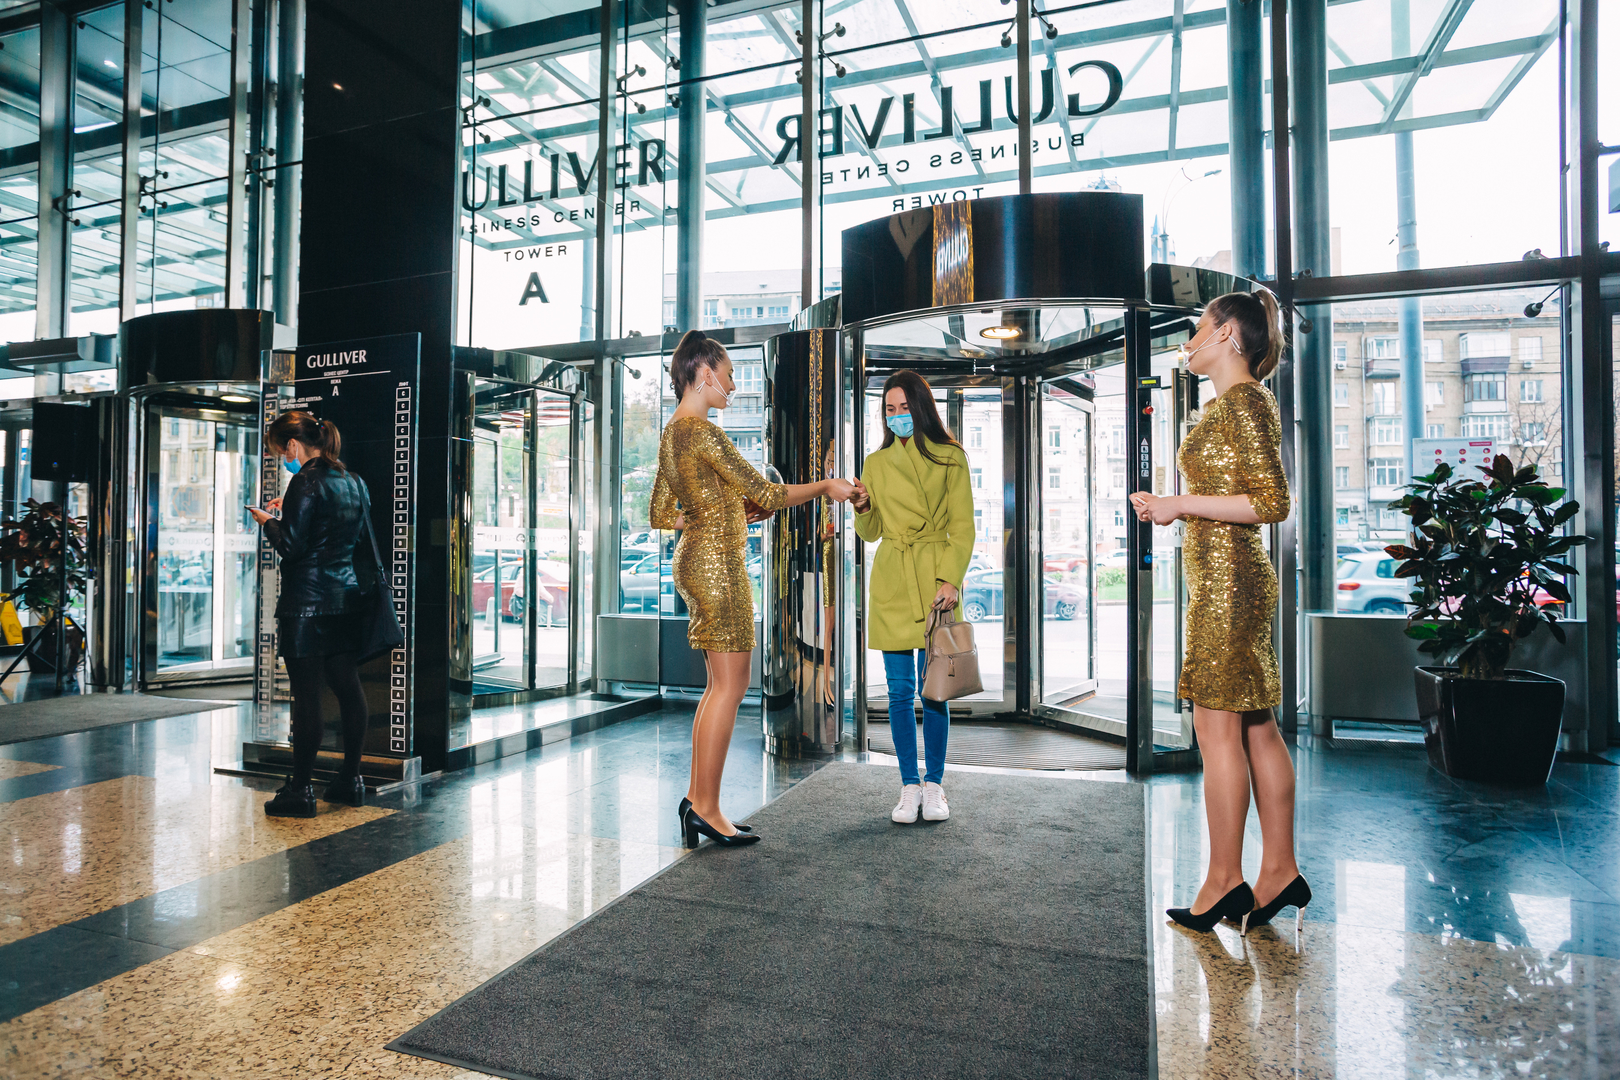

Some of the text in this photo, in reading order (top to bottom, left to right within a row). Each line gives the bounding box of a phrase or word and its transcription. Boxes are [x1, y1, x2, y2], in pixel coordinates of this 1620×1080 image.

[461, 137, 667, 213] ULLIVER
[461, 200, 641, 237] SINESS CENER
[503, 244, 568, 262] TOWER
[518, 271, 550, 306] A
[306, 349, 367, 368] GULLIVER
